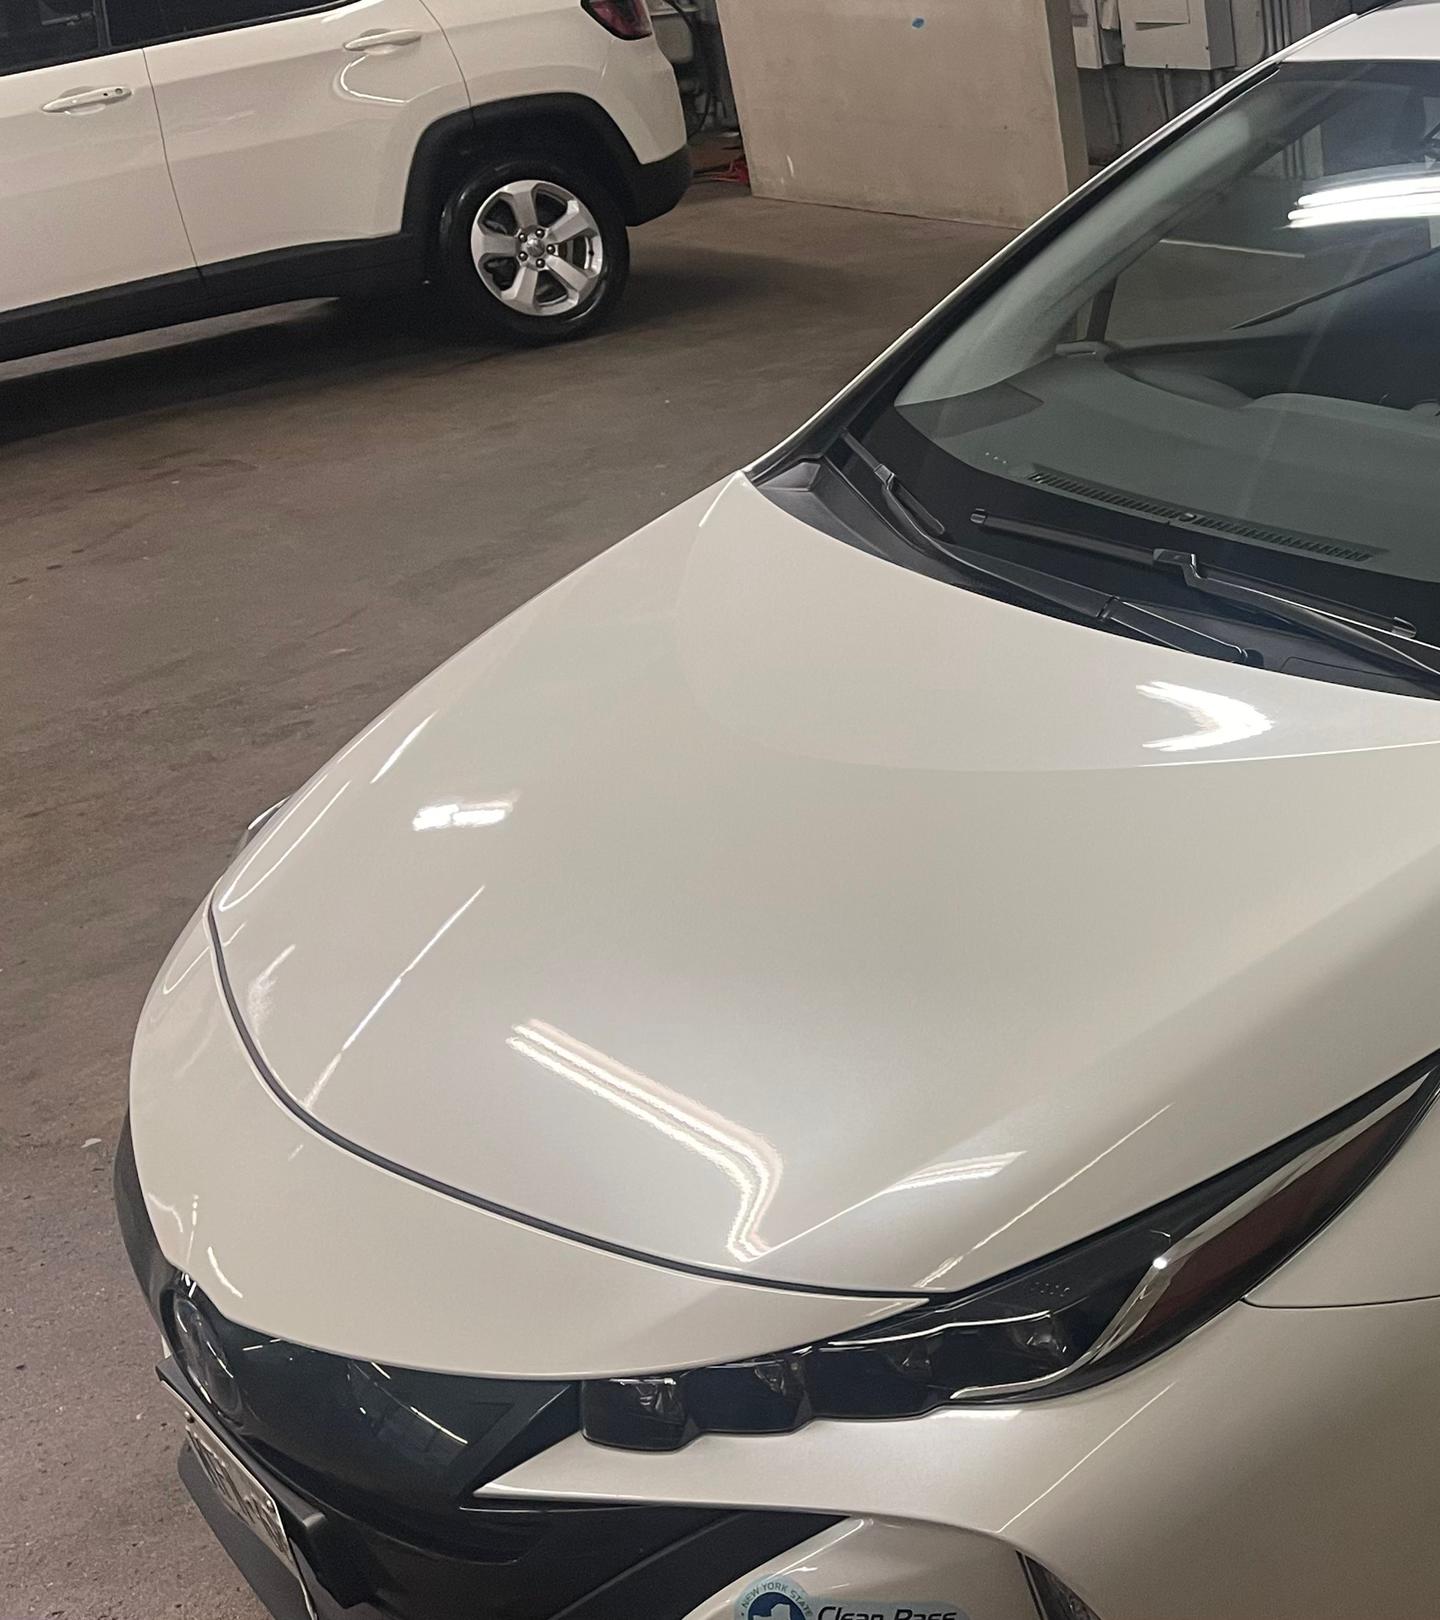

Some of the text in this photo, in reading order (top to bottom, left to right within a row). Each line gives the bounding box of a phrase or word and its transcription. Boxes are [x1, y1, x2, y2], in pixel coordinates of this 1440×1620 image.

[741, 1582, 814, 1617] NEW YORK STATE
